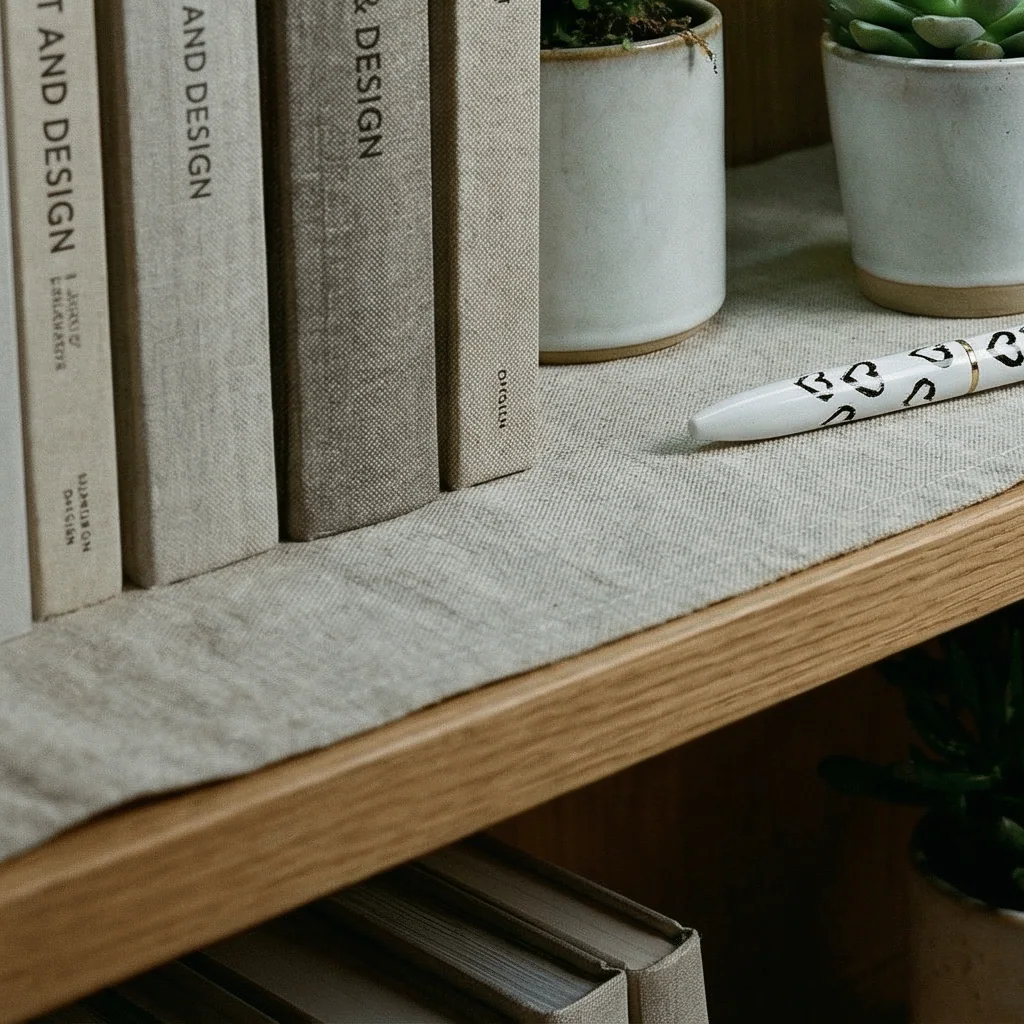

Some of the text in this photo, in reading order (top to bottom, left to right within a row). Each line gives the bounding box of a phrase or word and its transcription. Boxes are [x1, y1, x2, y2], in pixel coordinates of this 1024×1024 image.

[38, 27, 68, 106] AND
[182, 6, 208, 73] AND
[354, 25, 383, 159] DESIGN
[42, 117, 75, 254] DESIGN
[185, 82, 212, 200] DESIGN
